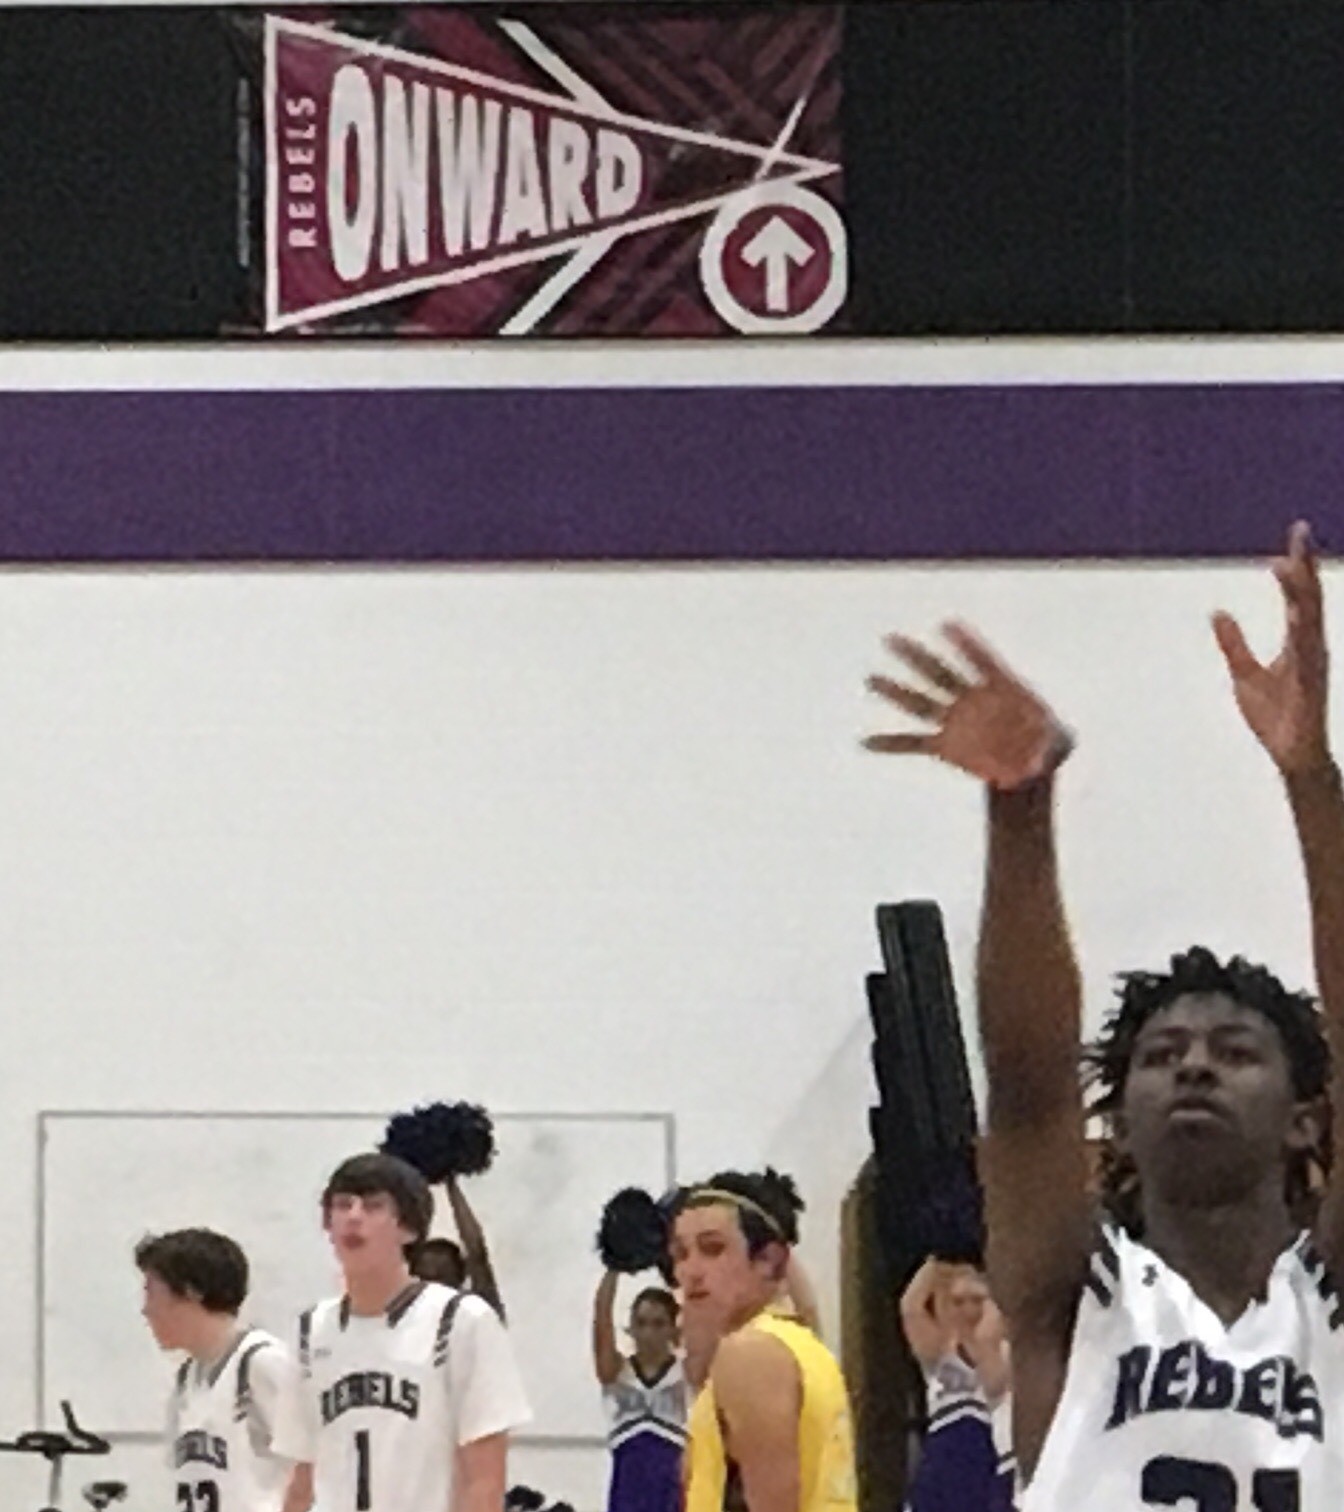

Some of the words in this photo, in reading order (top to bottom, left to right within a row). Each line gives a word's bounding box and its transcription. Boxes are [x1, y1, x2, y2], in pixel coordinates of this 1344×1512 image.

[285, 97, 317, 247] REBELS
[327, 63, 643, 282] ONWARD
[355, 1429, 371, 1512] 1
